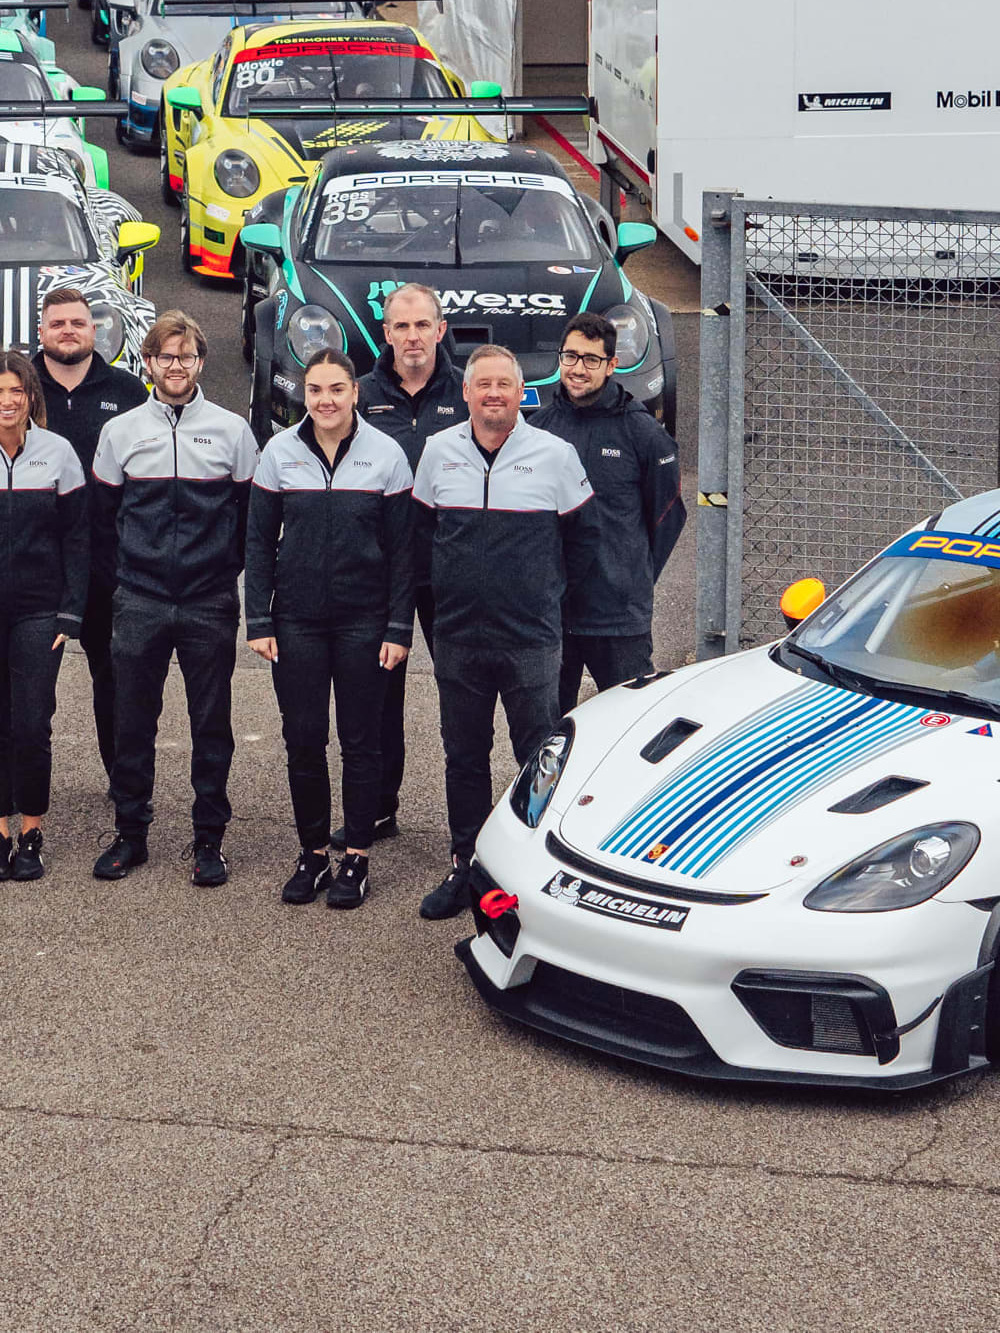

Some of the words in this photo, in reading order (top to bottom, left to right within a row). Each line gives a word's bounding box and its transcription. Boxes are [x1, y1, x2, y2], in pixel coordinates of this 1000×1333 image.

[275, 36, 351, 44] TIGERMONKEY
[257, 44, 413, 56] PORSCHE
[237, 57, 284, 73] Mowle
[236, 67, 275, 89] 80
[824, 97, 884, 107] MICHELIN
[936, 91, 991, 108] Mobil
[353, 173, 544, 187] PORSCHE
[327, 189, 369, 203] Rees
[322, 201, 370, 226] 35
[434, 290, 566, 309] Wera
[193, 437, 212, 445] BOSS
[514, 465, 533, 473] BOSS
[582, 890, 687, 924] MICHELIN
